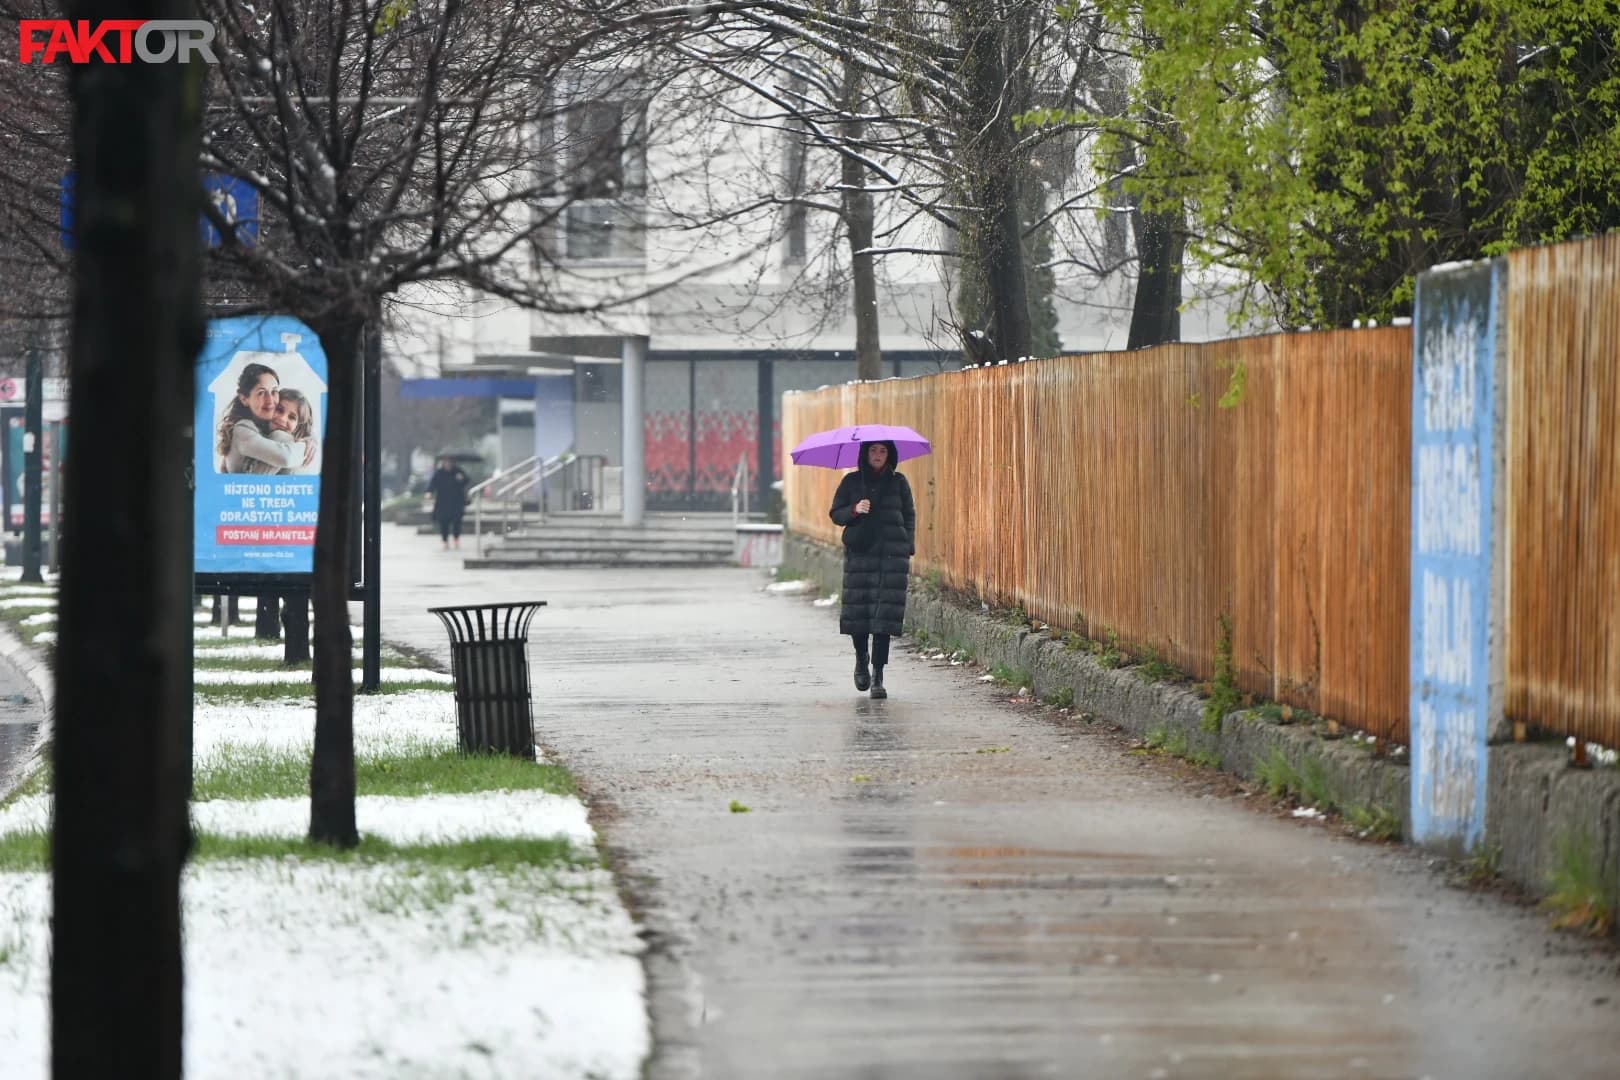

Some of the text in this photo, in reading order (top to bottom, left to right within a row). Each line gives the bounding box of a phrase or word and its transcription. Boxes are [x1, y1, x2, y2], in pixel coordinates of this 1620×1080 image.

[224, 482, 314, 496] NIJEDNO DIJETE
[242, 498, 295, 509] NE TREBA
[220, 510, 318, 523] ODRASTATI SAMO
